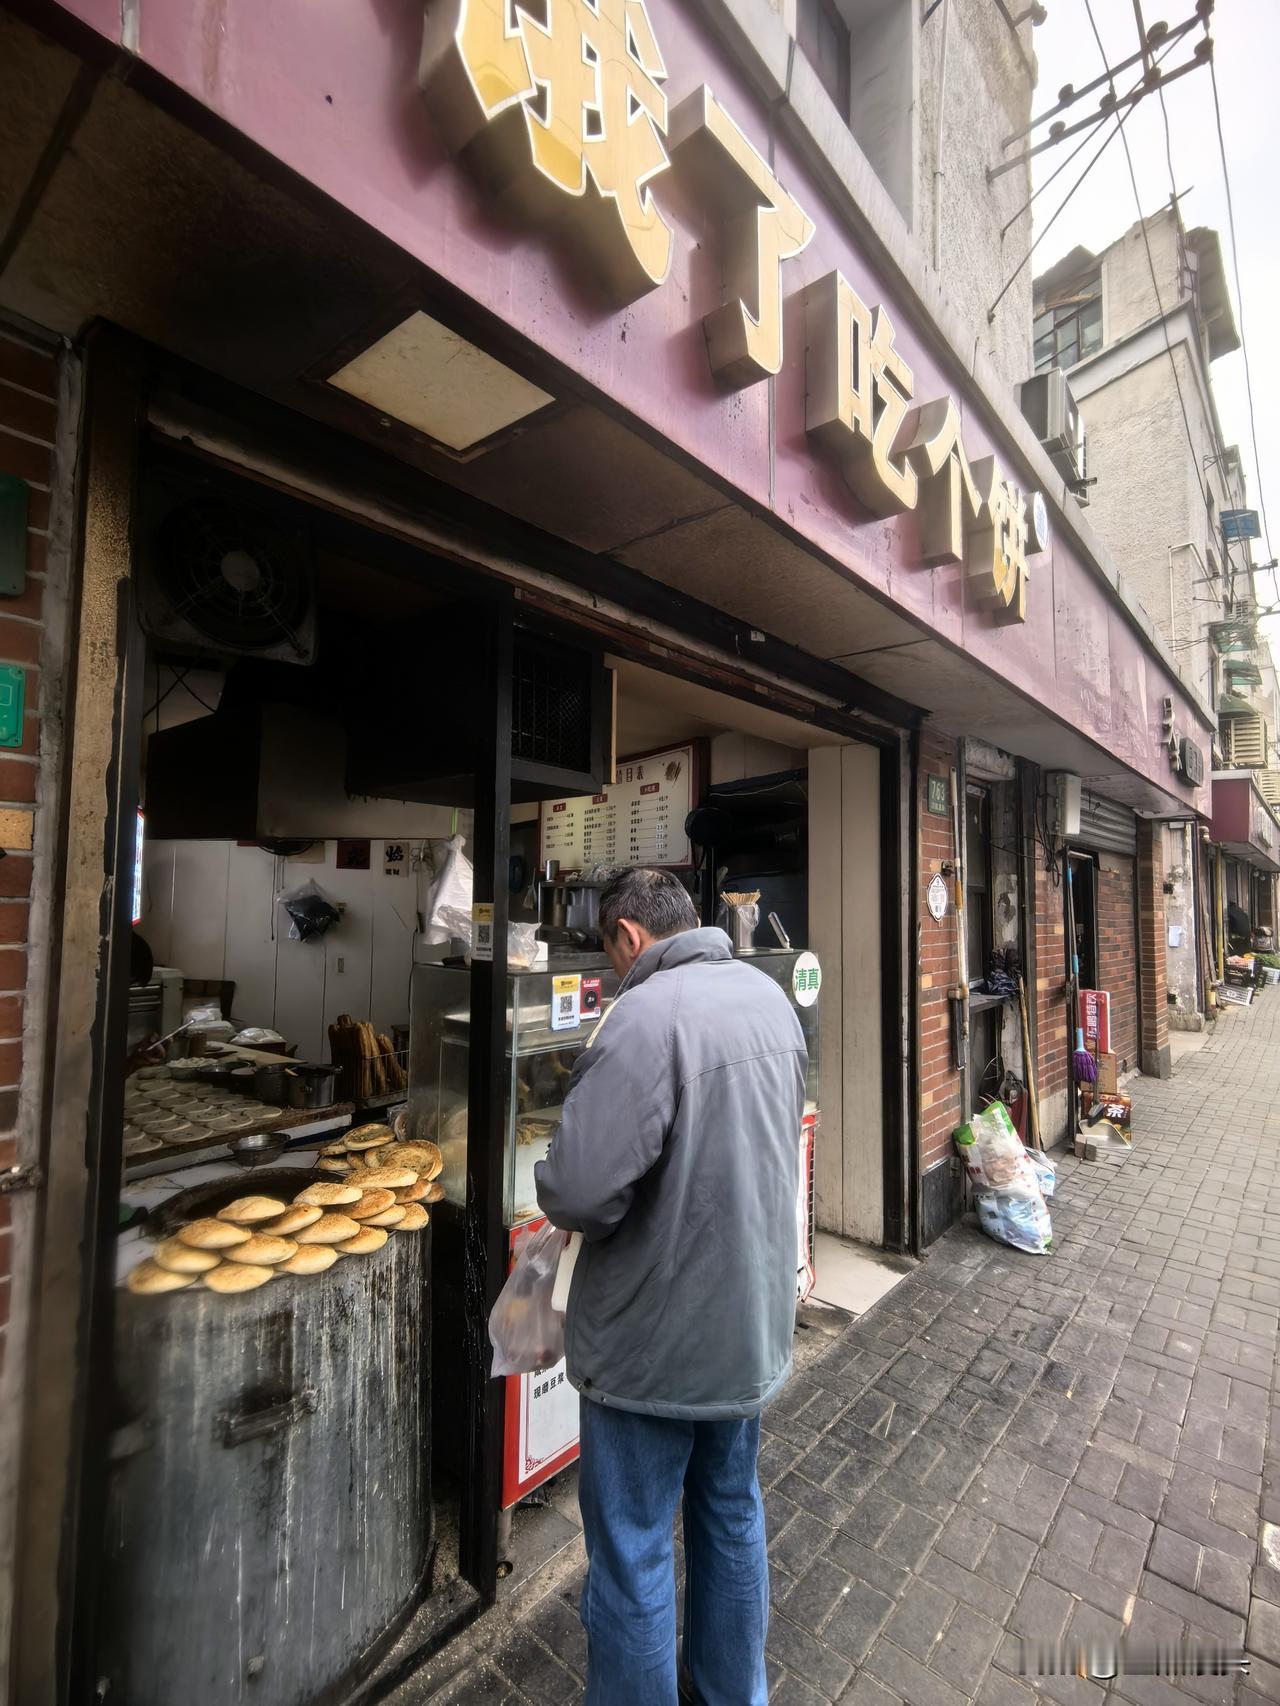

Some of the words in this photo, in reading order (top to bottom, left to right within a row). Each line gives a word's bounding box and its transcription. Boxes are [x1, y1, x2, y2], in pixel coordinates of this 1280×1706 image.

[931, 780, 945, 801] 763
[795, 968, 819, 991] 清真
[1104, 1103, 1125, 1118] 茶
[533, 1371, 565, 1400] 现磨豆浆
